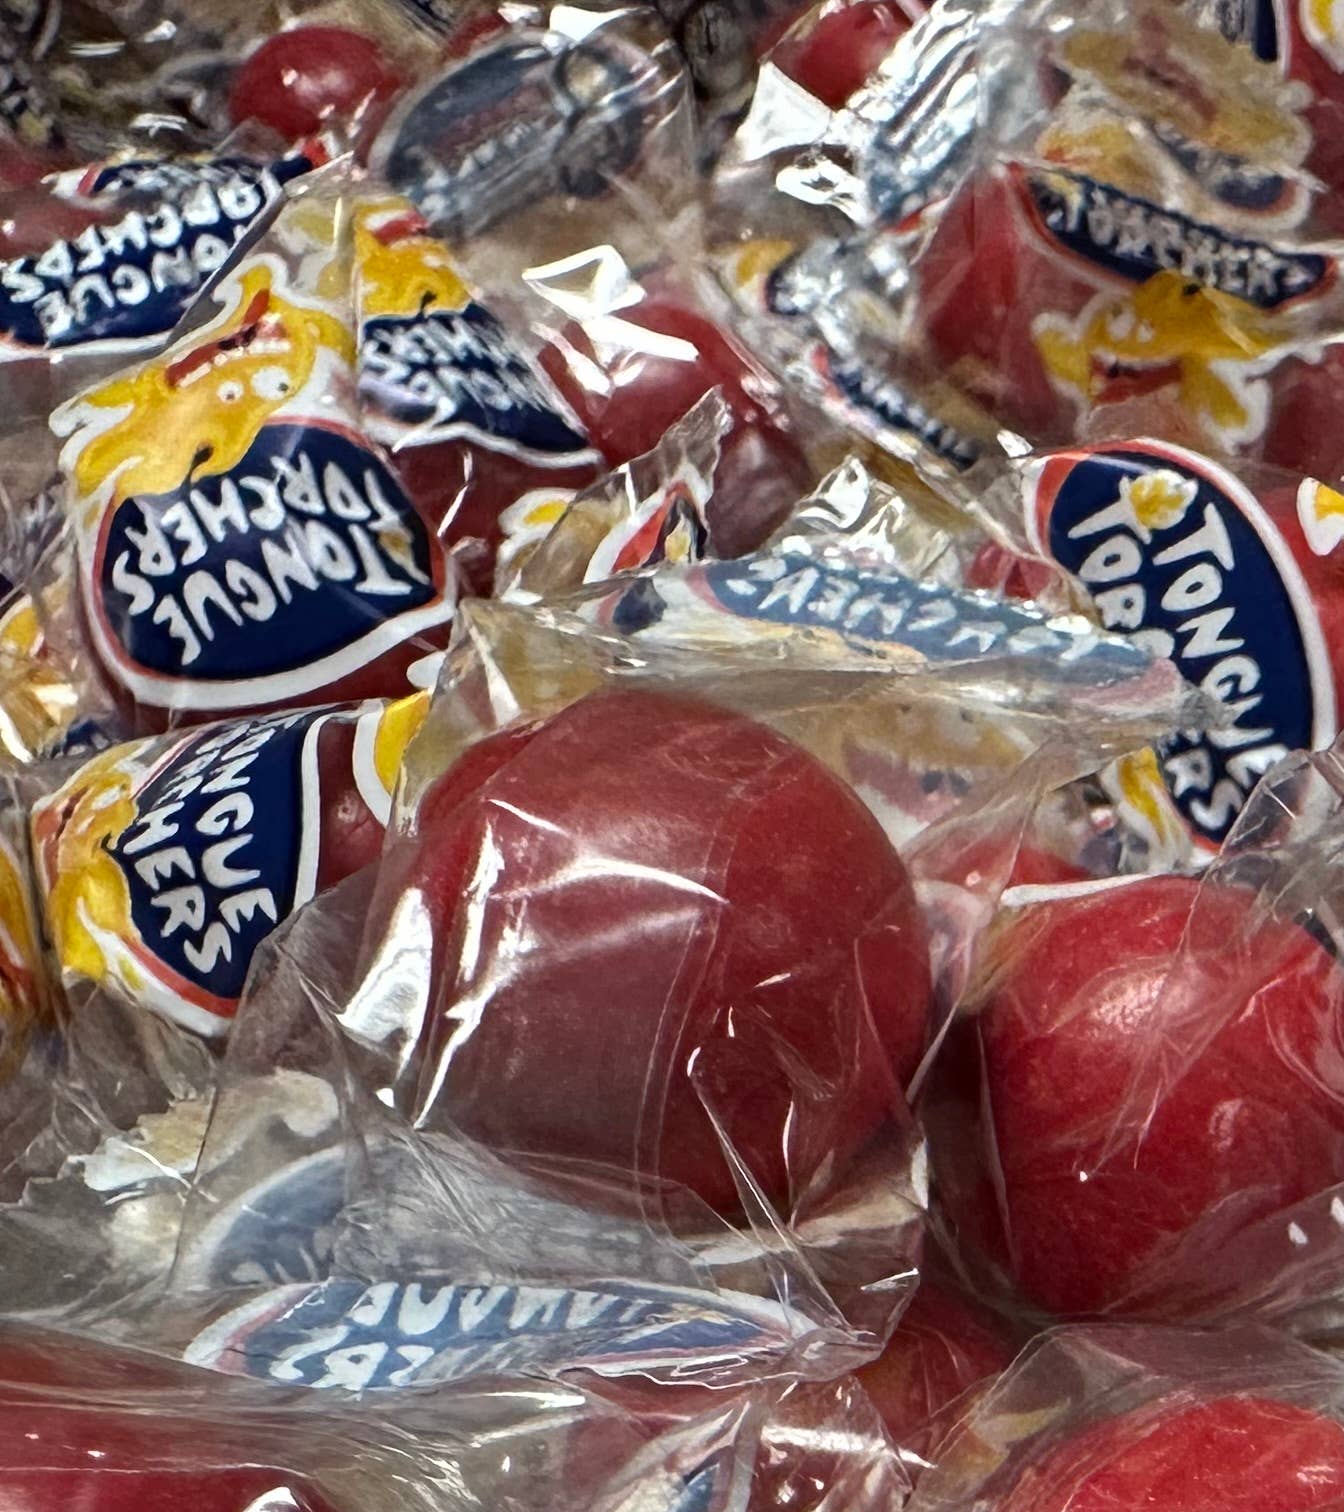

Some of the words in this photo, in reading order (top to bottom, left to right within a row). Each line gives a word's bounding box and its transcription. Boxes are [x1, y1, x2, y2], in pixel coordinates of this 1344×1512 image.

[33, 222, 250, 338] ONGUE
[113, 451, 412, 617] TORCHERS
[153, 523, 413, 666] TONGUE
[196, 712, 304, 934] ONGUE
